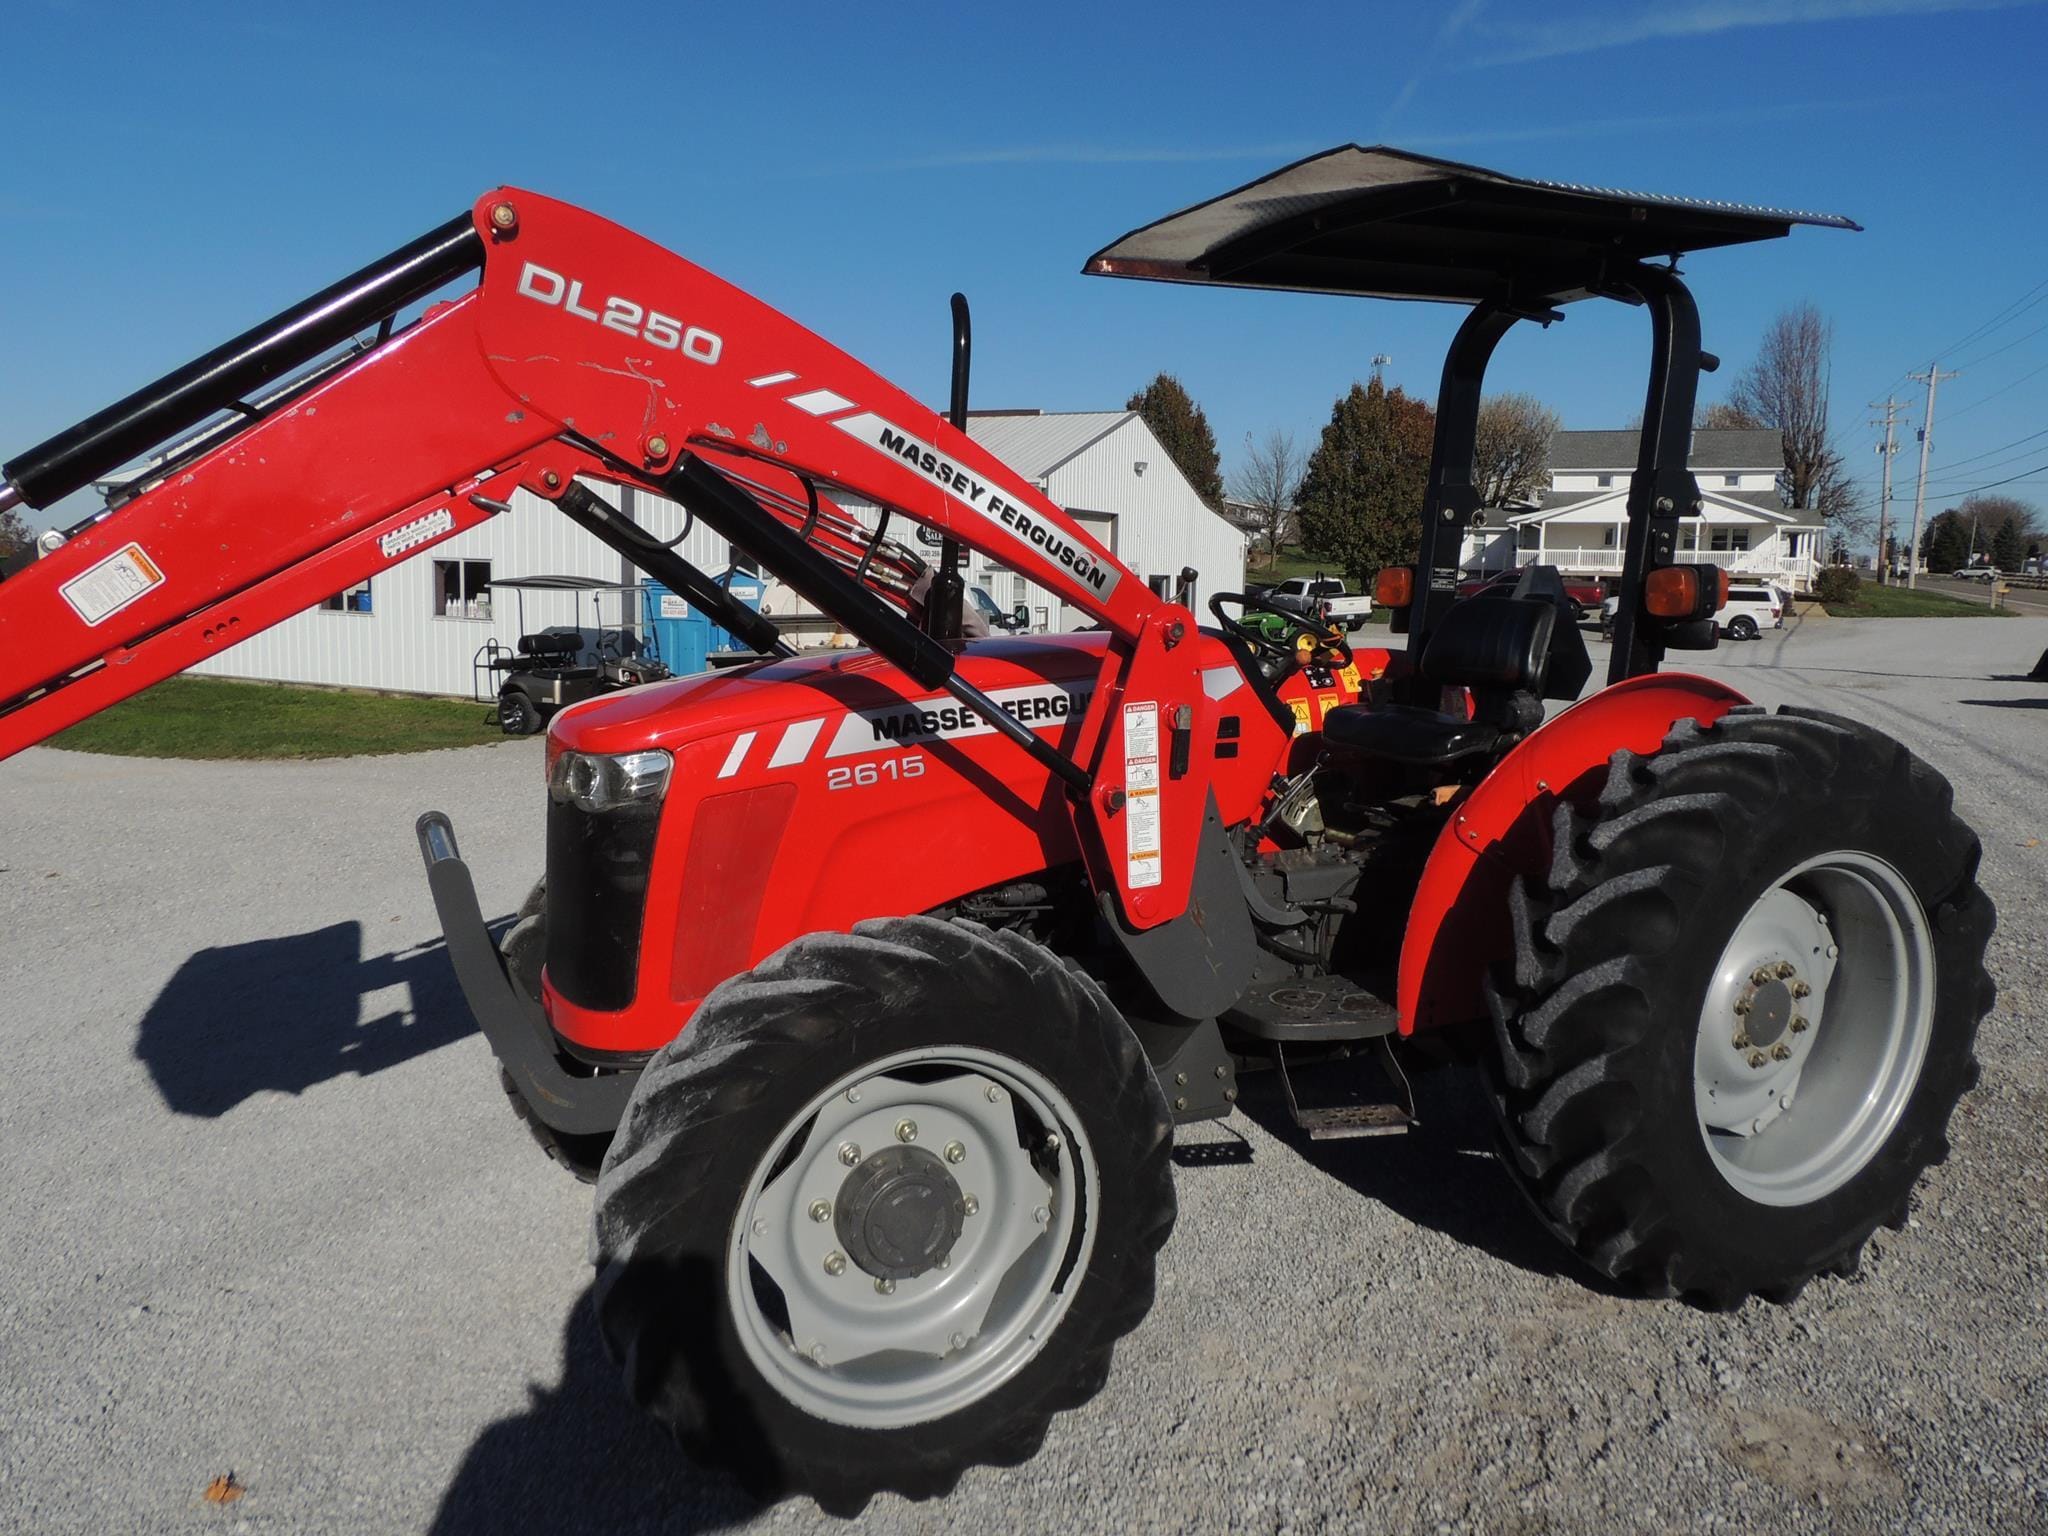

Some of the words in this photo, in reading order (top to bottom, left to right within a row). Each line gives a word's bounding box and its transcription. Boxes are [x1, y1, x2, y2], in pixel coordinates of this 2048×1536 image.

[517, 260, 724, 366] DL250
[879, 427, 986, 502] MASSEY
[987, 495, 1107, 590] FERGUSON
[872, 706, 990, 742] MASSE
[1132, 703, 1155, 712] DANGER
[827, 755, 925, 790] 2615
[1134, 756, 1156, 764] DANGER
